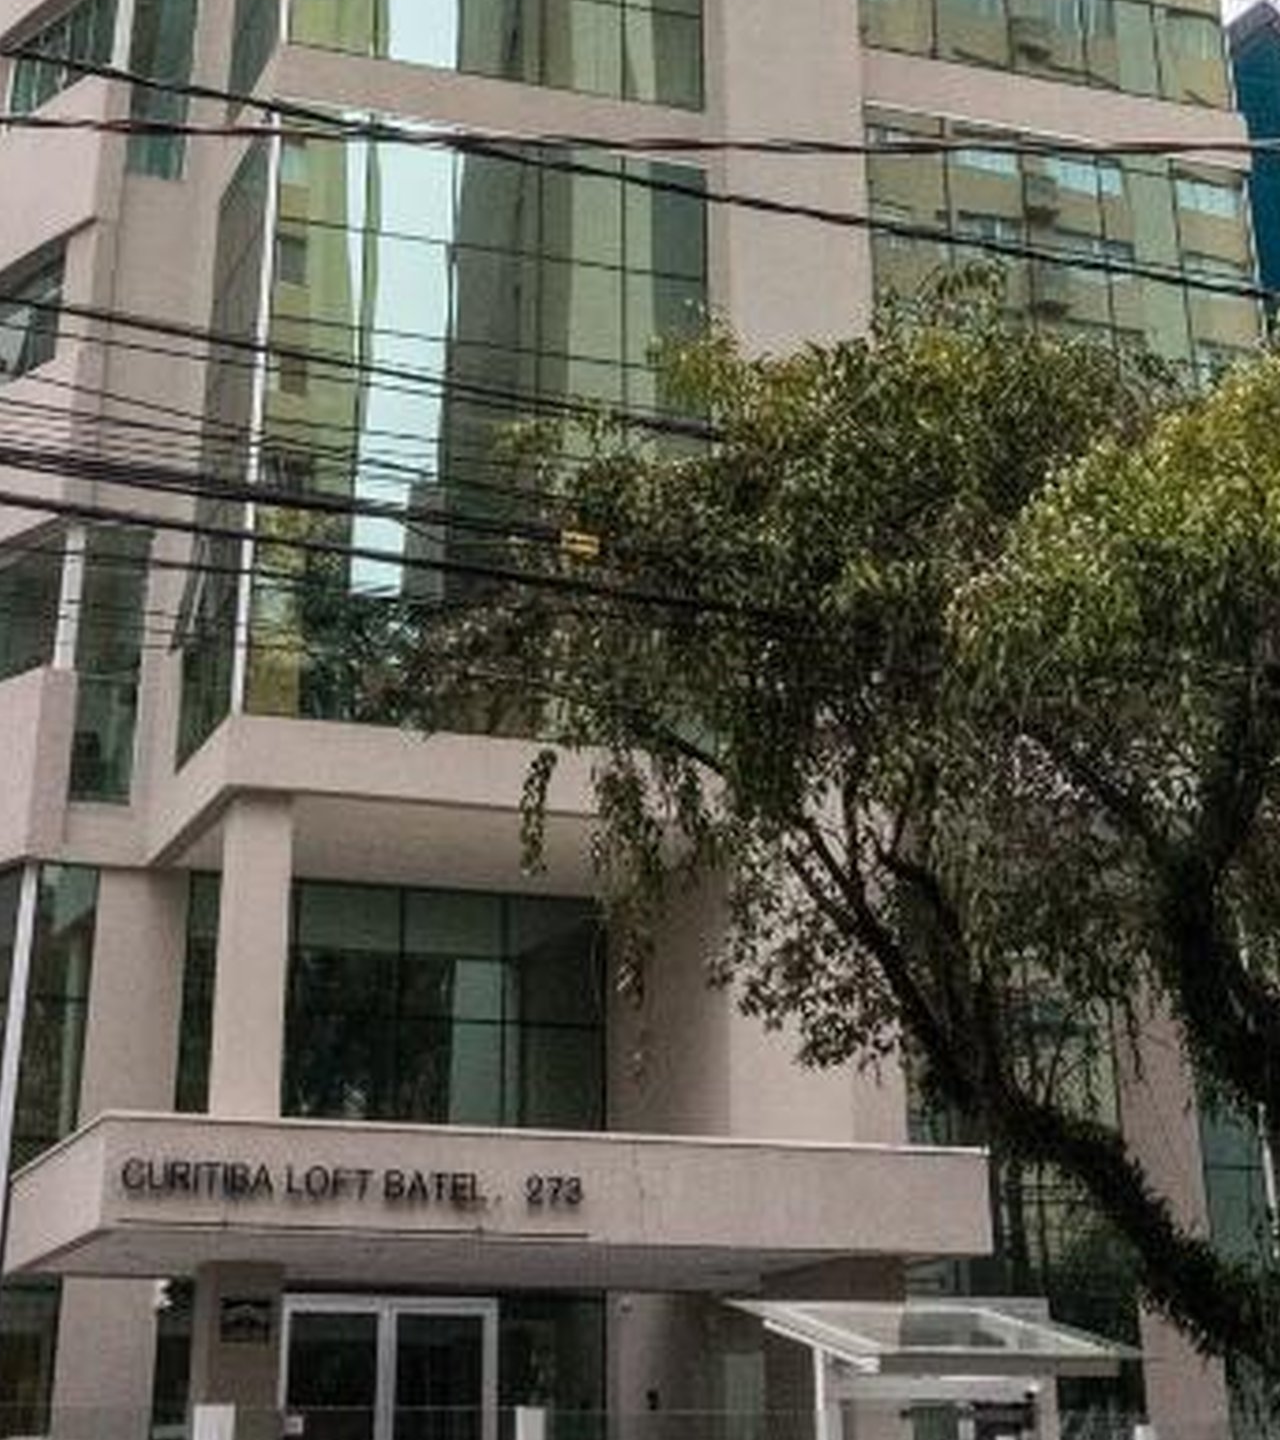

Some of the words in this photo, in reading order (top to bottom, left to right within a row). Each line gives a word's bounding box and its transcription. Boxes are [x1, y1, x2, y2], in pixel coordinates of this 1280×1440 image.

[121, 1156, 274, 1198] CURITIBA
[286, 1165, 373, 1202] LOFT
[526, 1174, 584, 1205] 273
